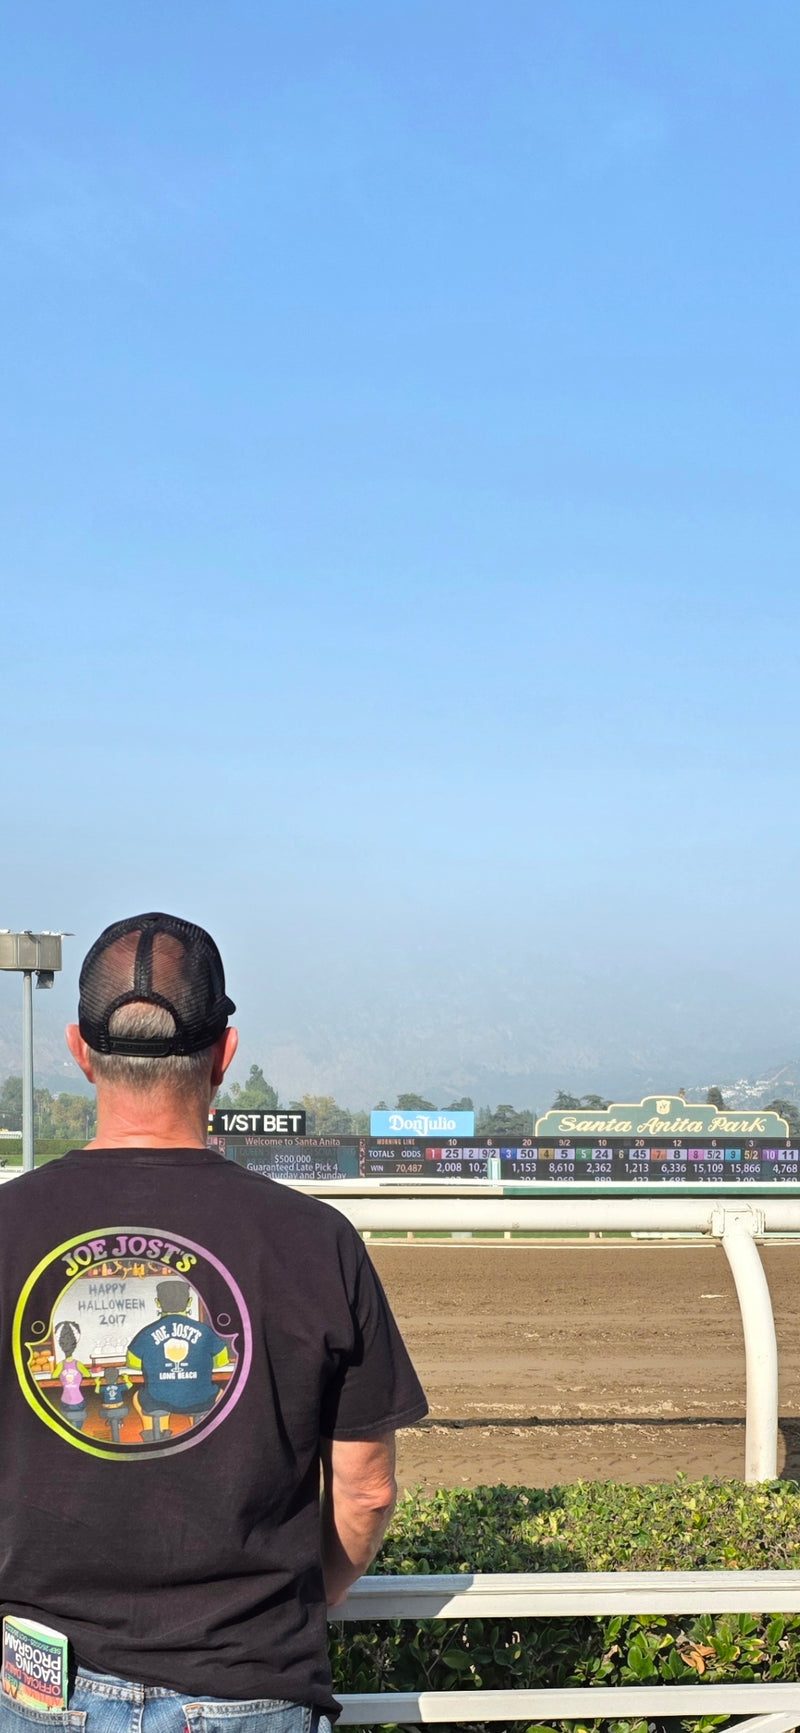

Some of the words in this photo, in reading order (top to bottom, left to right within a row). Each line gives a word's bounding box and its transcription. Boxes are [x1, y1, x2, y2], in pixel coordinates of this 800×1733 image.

[221, 1114, 261, 1131] 1/ST
[263, 1115, 301, 1132] BET
[558, 1116, 632, 1132] Santa
[637, 1116, 703, 1134] Anita
[707, 1116, 767, 1132] Park
[245, 1138, 283, 1146] Welcome
[284, 1138, 292, 1146] to
[295, 1138, 318, 1146] Santa
[319, 1138, 341, 1146] Anita
[369, 1149, 395, 1158] TOTALS
[401, 1149, 421, 1158] ODDS
[445, 1149, 459, 1158] 25
[468, 1149, 474, 1158] 2
[506, 1150, 512, 1159] 3
[520, 1150, 534, 1159] 50
[543, 1150, 549, 1159] 4
[560, 1150, 568, 1159] 5
[595, 1150, 609, 1159] 24
[618, 1150, 624, 1159] 6
[632, 1150, 647, 1159] 45
[656, 1150, 662, 1159] 7
[673, 1150, 681, 1159] 8
[707, 1150, 721, 1159] 5/2
[744, 1150, 759, 1159] 5/2
[766, 1150, 776, 1159] 10
[782, 1151, 794, 1160] 11
[247, 1163, 294, 1172] Guaranteed
[296, 1163, 313, 1172] Late
[315, 1163, 331, 1171] Pick
[332, 1163, 338, 1171] 4
[370, 1163, 384, 1174] WIN
[395, 1163, 422, 1174] 70,487
[436, 1163, 462, 1174] 2,008
[511, 1162, 537, 1173] 1,153
[548, 1162, 575, 1173] 8,610
[586, 1162, 612, 1173] 2,362
[625, 1162, 649, 1173] 1,213
[661, 1163, 687, 1174] 6,336
[693, 1163, 724, 1174] 15,109
[731, 1163, 761, 1174] 15,866
[772, 1163, 798, 1174] 4,768
[299, 1171, 315, 1179] and
[316, 1171, 346, 1179] Sunday
[61, 1240, 108, 1277] JOE
[112, 1236, 198, 1273] JOST'S
[89, 1283, 127, 1295] HAPPY
[78, 1298, 146, 1311] HALLOWEEN
[99, 1315, 127, 1325] 2017
[151, 1325, 168, 1345] JOE
[159, 1372, 176, 1380] LONG
[177, 1371, 198, 1379] BEACH
[5, 1631, 62, 1670] PROGRAM
[15, 1653, 61, 1685] RACING
[22, 1672, 61, 1695] OFFICIAL
